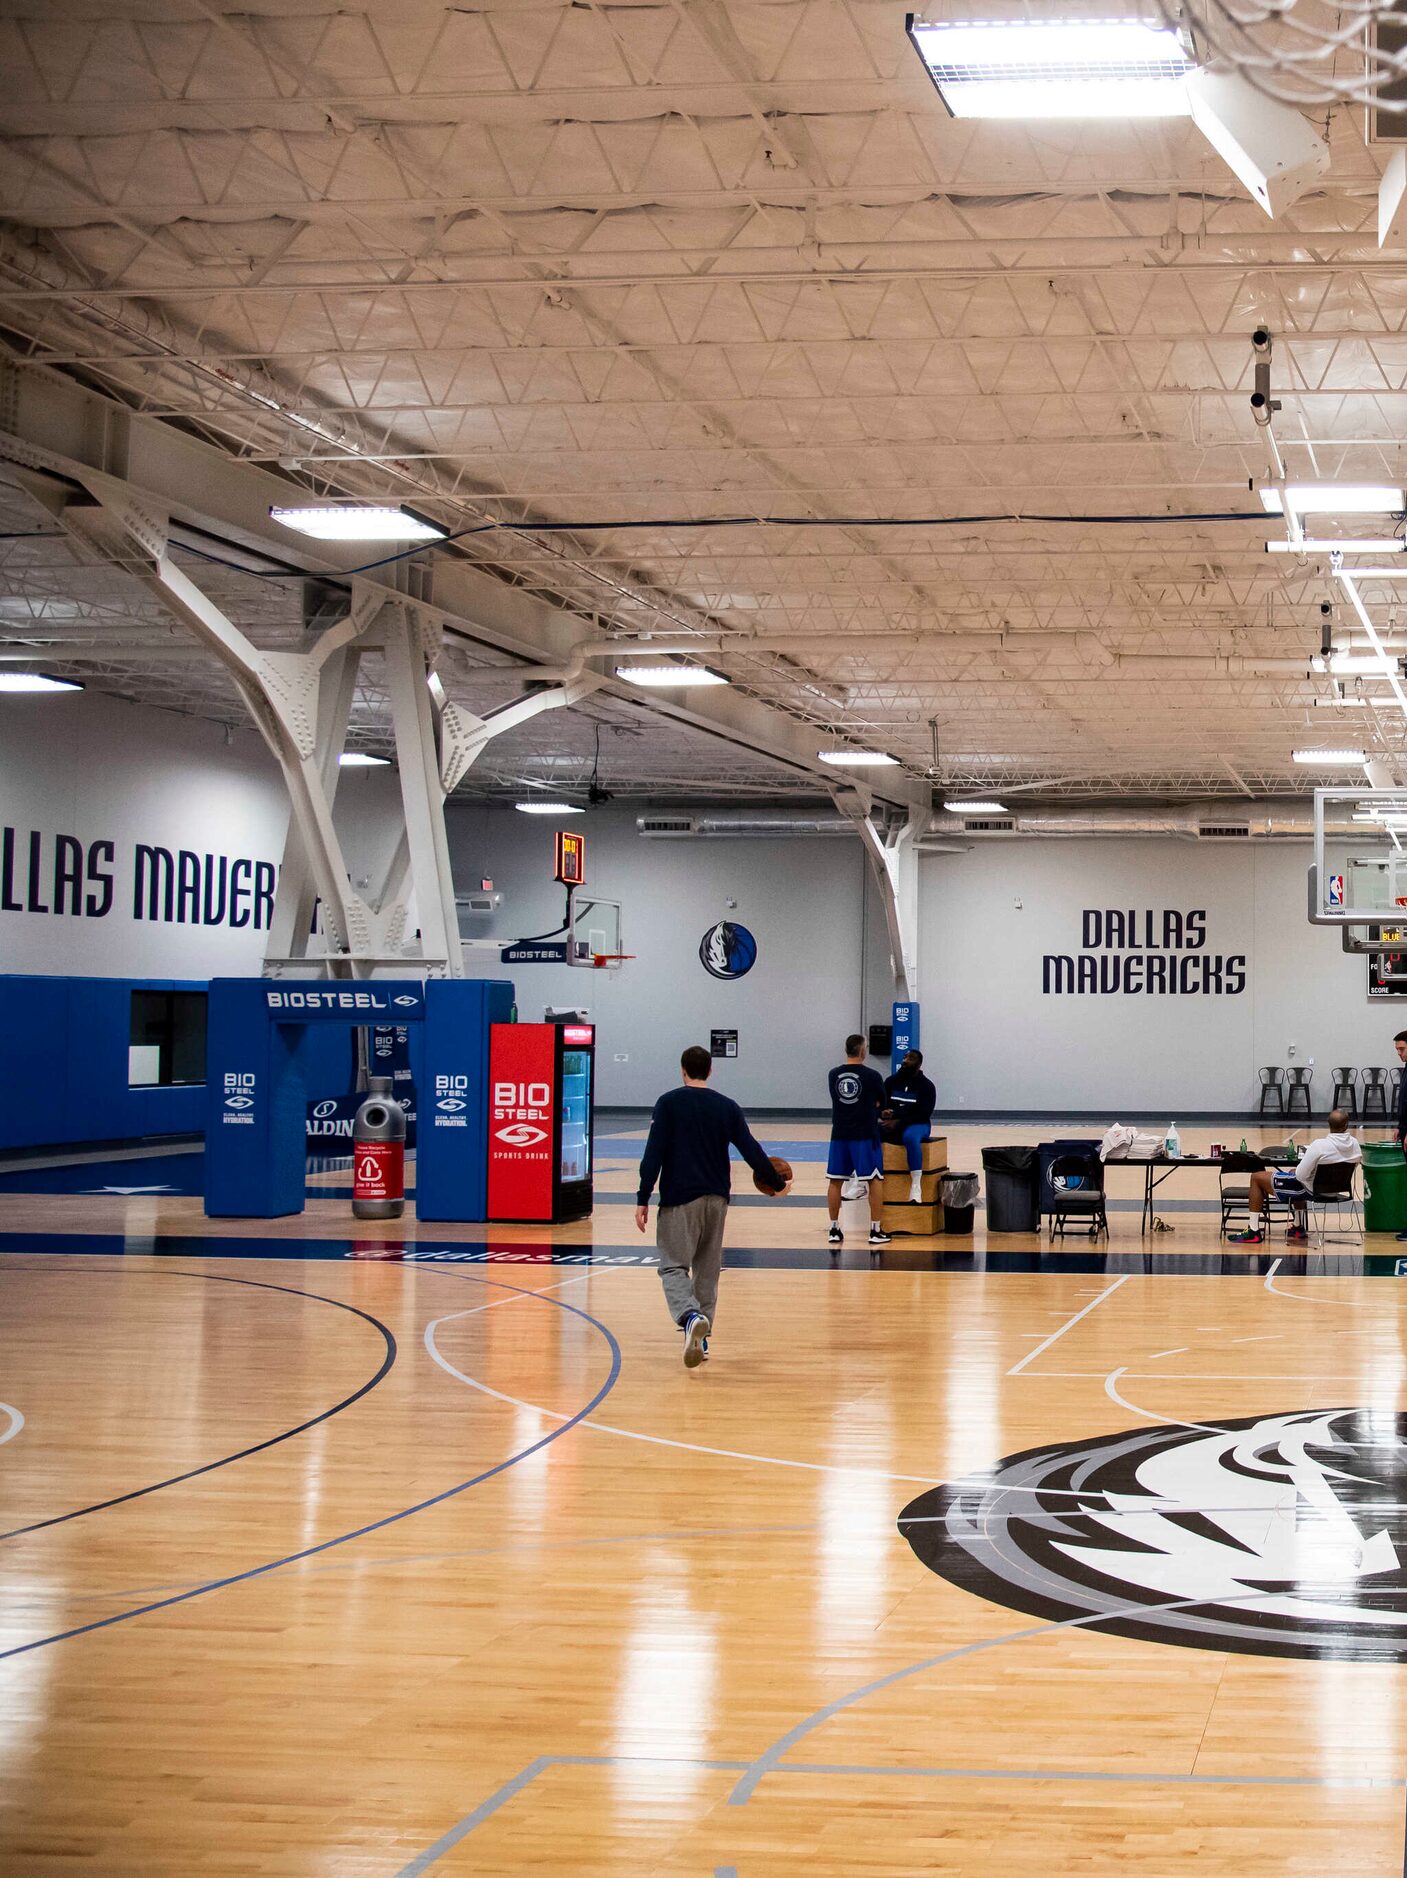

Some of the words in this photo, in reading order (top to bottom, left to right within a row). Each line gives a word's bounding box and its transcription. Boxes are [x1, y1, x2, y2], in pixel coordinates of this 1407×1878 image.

[2, 827, 115, 917] LLAS
[134, 844, 276, 931] MAVER
[1083, 910, 1206, 949] DALLAS
[509, 951, 562, 959] BIOSTEEL
[1042, 955, 1246, 995] MAVERICKS
[267, 992, 386, 1008] BIOSTEEL
[376, 1036, 392, 1044] BIO
[224, 1073, 255, 1086] BIO
[436, 1075, 467, 1089] BIO
[494, 1083, 550, 1106] BIO
[494, 1109, 550, 1120] STEEL
[306, 1119, 355, 1137] ALDIN
[526, 1152, 549, 1160] DRINK
[344, 1249, 661, 1264] @dallasmav
